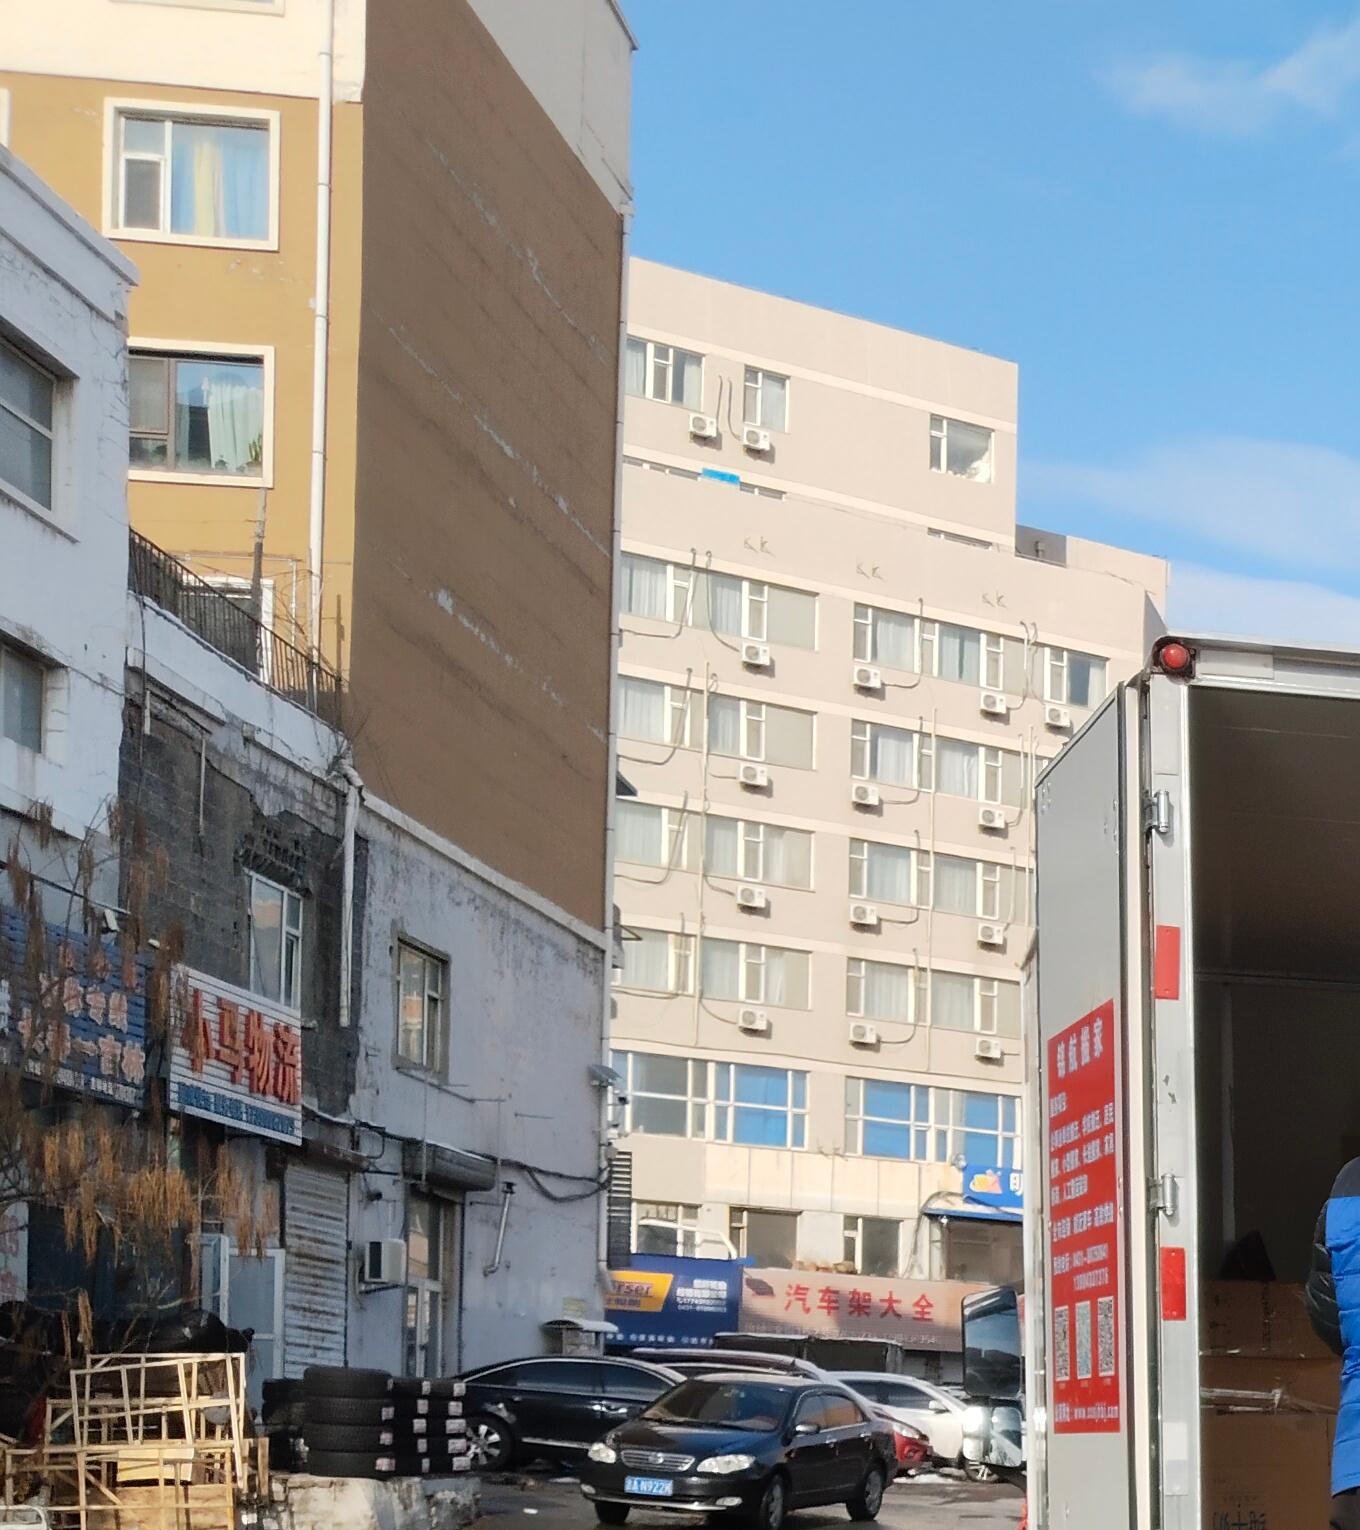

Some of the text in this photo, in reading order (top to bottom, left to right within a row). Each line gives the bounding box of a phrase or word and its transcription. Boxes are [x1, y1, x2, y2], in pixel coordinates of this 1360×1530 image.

[783, 1284, 934, 1322] 汽车架大全
